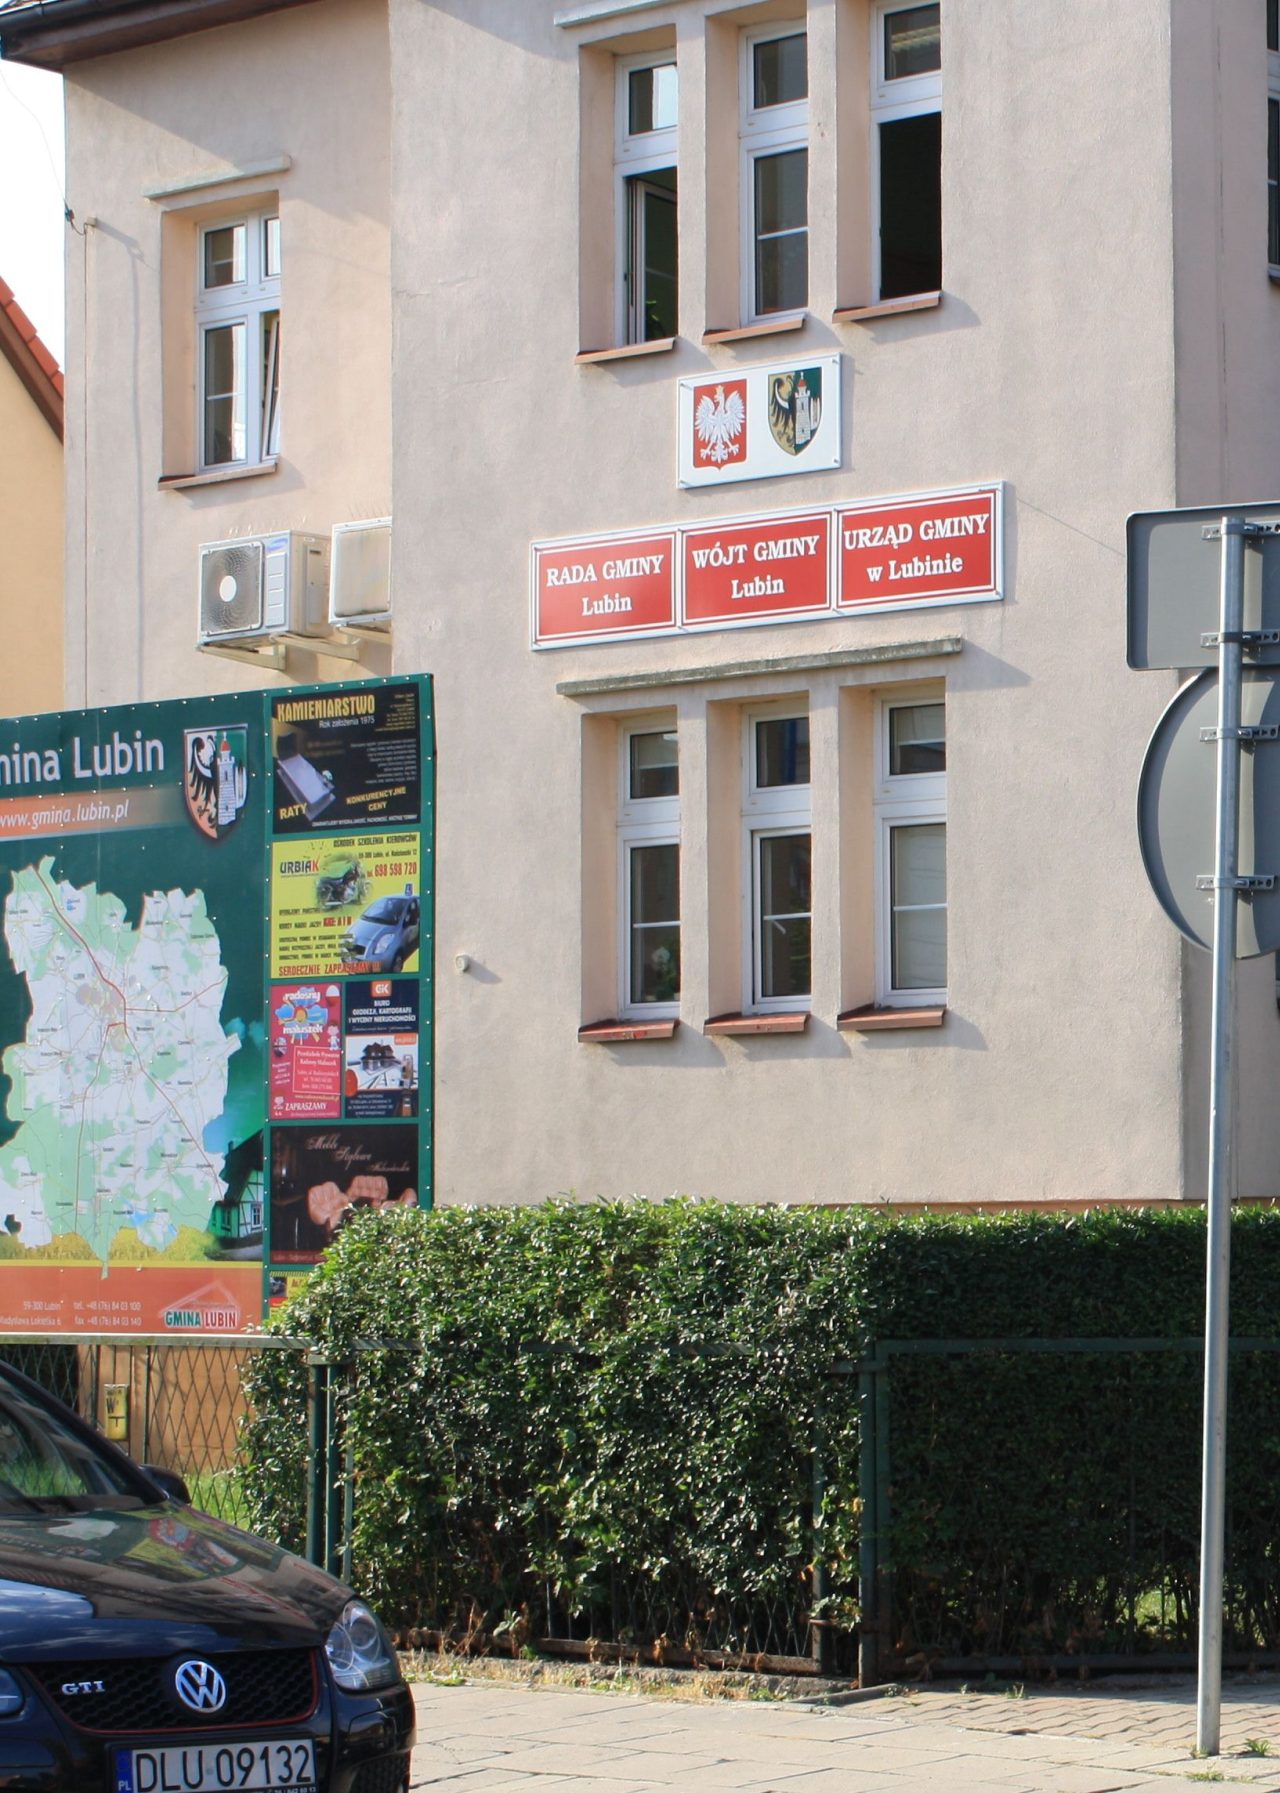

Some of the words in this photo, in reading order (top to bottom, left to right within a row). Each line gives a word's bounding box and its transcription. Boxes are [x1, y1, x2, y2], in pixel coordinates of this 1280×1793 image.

[844, 522, 913, 551] URZĄD
[922, 513, 989, 542] GMINY
[693, 541, 747, 569] WÓJT
[753, 535, 820, 561] GMINY
[546, 560, 597, 587] RADA
[602, 555, 664, 580] GMINY
[867, 566, 882, 583] w
[887, 555, 964, 579] Lubinie
[731, 575, 784, 600] Lubin
[582, 593, 632, 616] Lubin
[277, 694, 375, 722] KAMIENIARSTWO
[360, 716, 375, 725] 1975
[74, 730, 164, 778] Lubin
[279, 803, 308, 820] RATY
[280, 858, 319, 874] URBIAK
[165, 1311, 201, 1327] GMINA
[205, 1311, 236, 1326] LUBIN
[61, 1680, 106, 1696] GTI
[136, 1750, 204, 1793] DLU
[216, 1745, 311, 1787] 09132
[118, 1780, 132, 1791] PL
